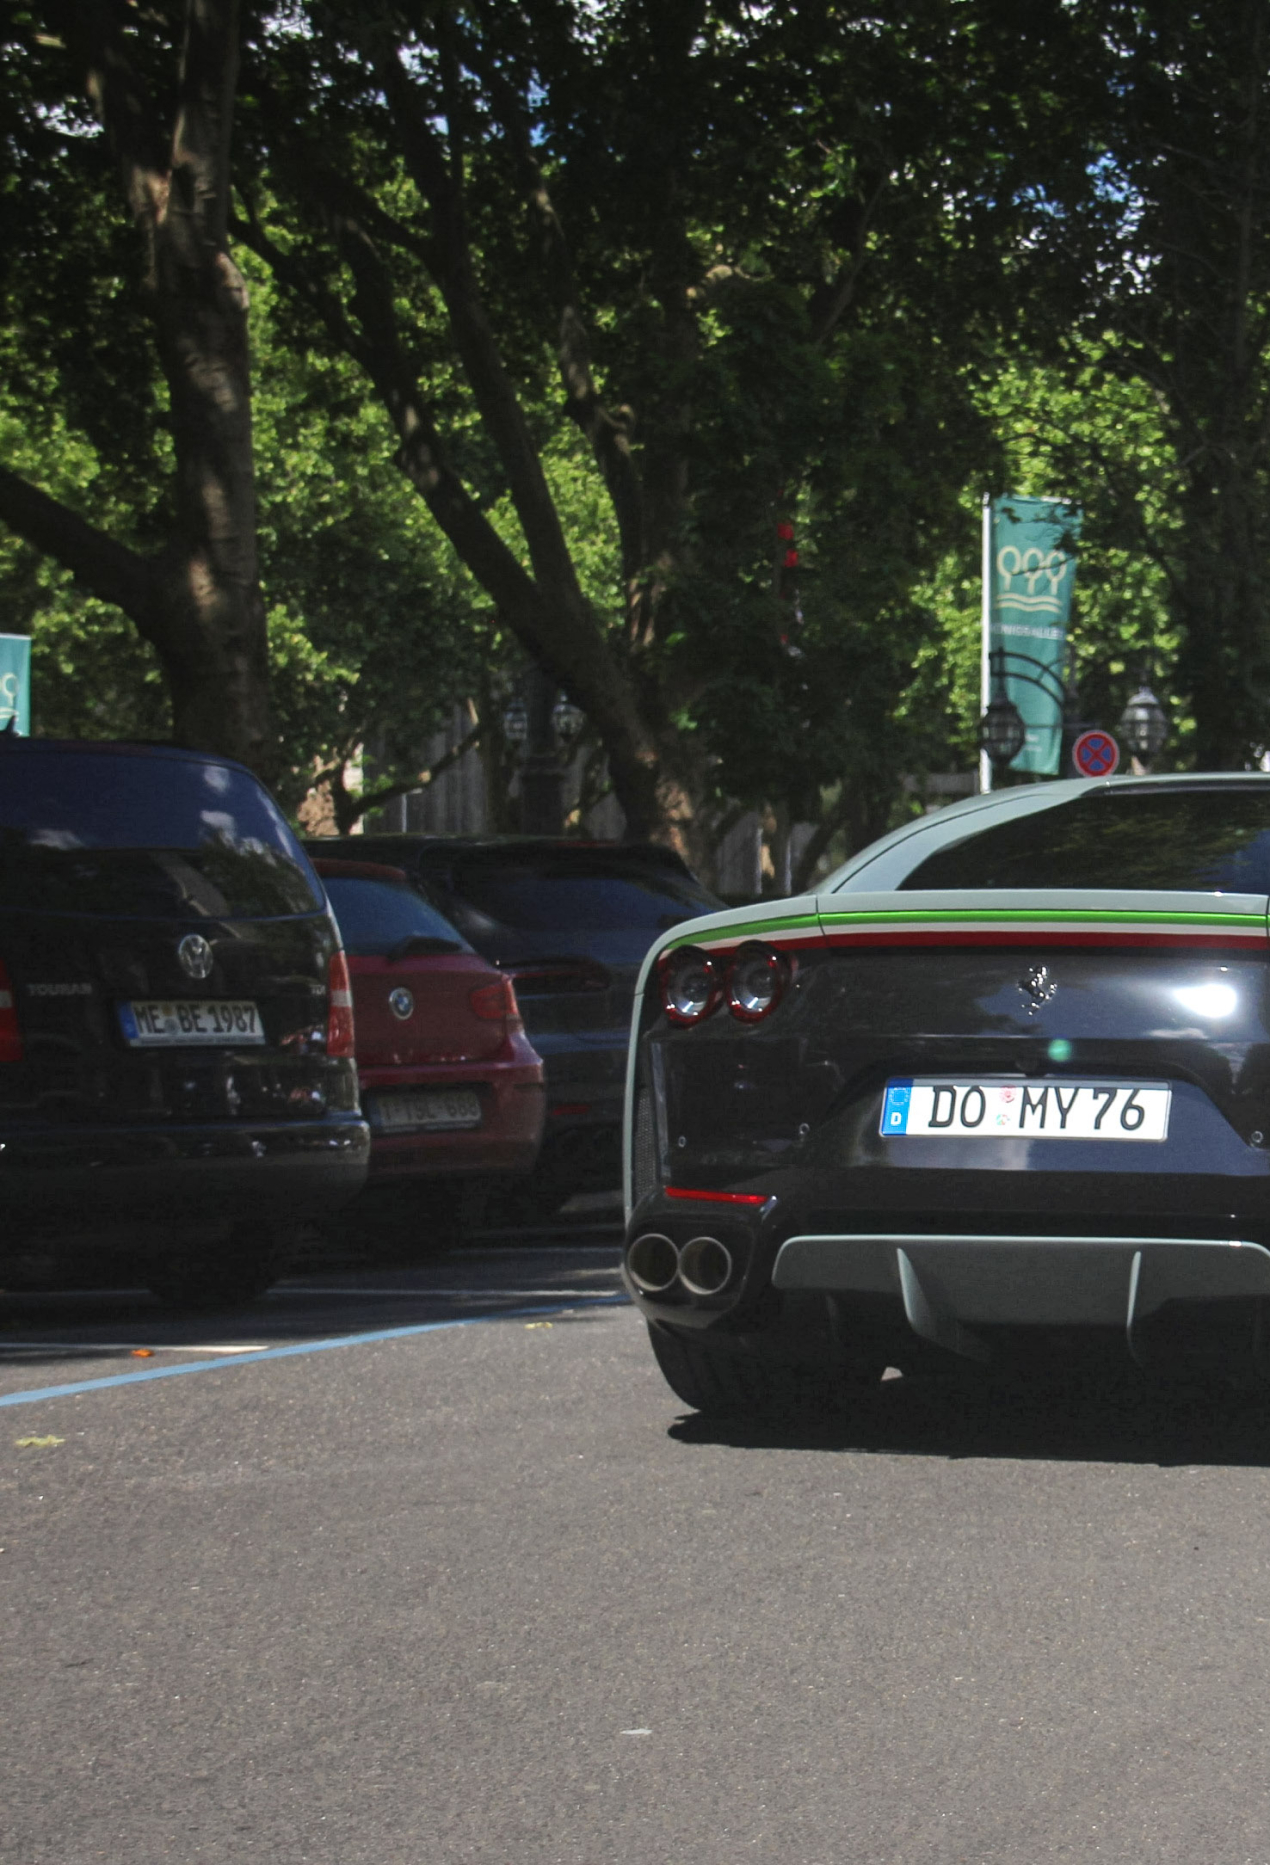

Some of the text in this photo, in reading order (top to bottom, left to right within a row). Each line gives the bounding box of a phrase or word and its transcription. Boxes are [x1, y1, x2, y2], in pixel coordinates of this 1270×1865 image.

[133, 1004, 256, 1033] ME BE 1987
[891, 1112, 902, 1126] D
[928, 1085, 1146, 1131] DO MY 76
